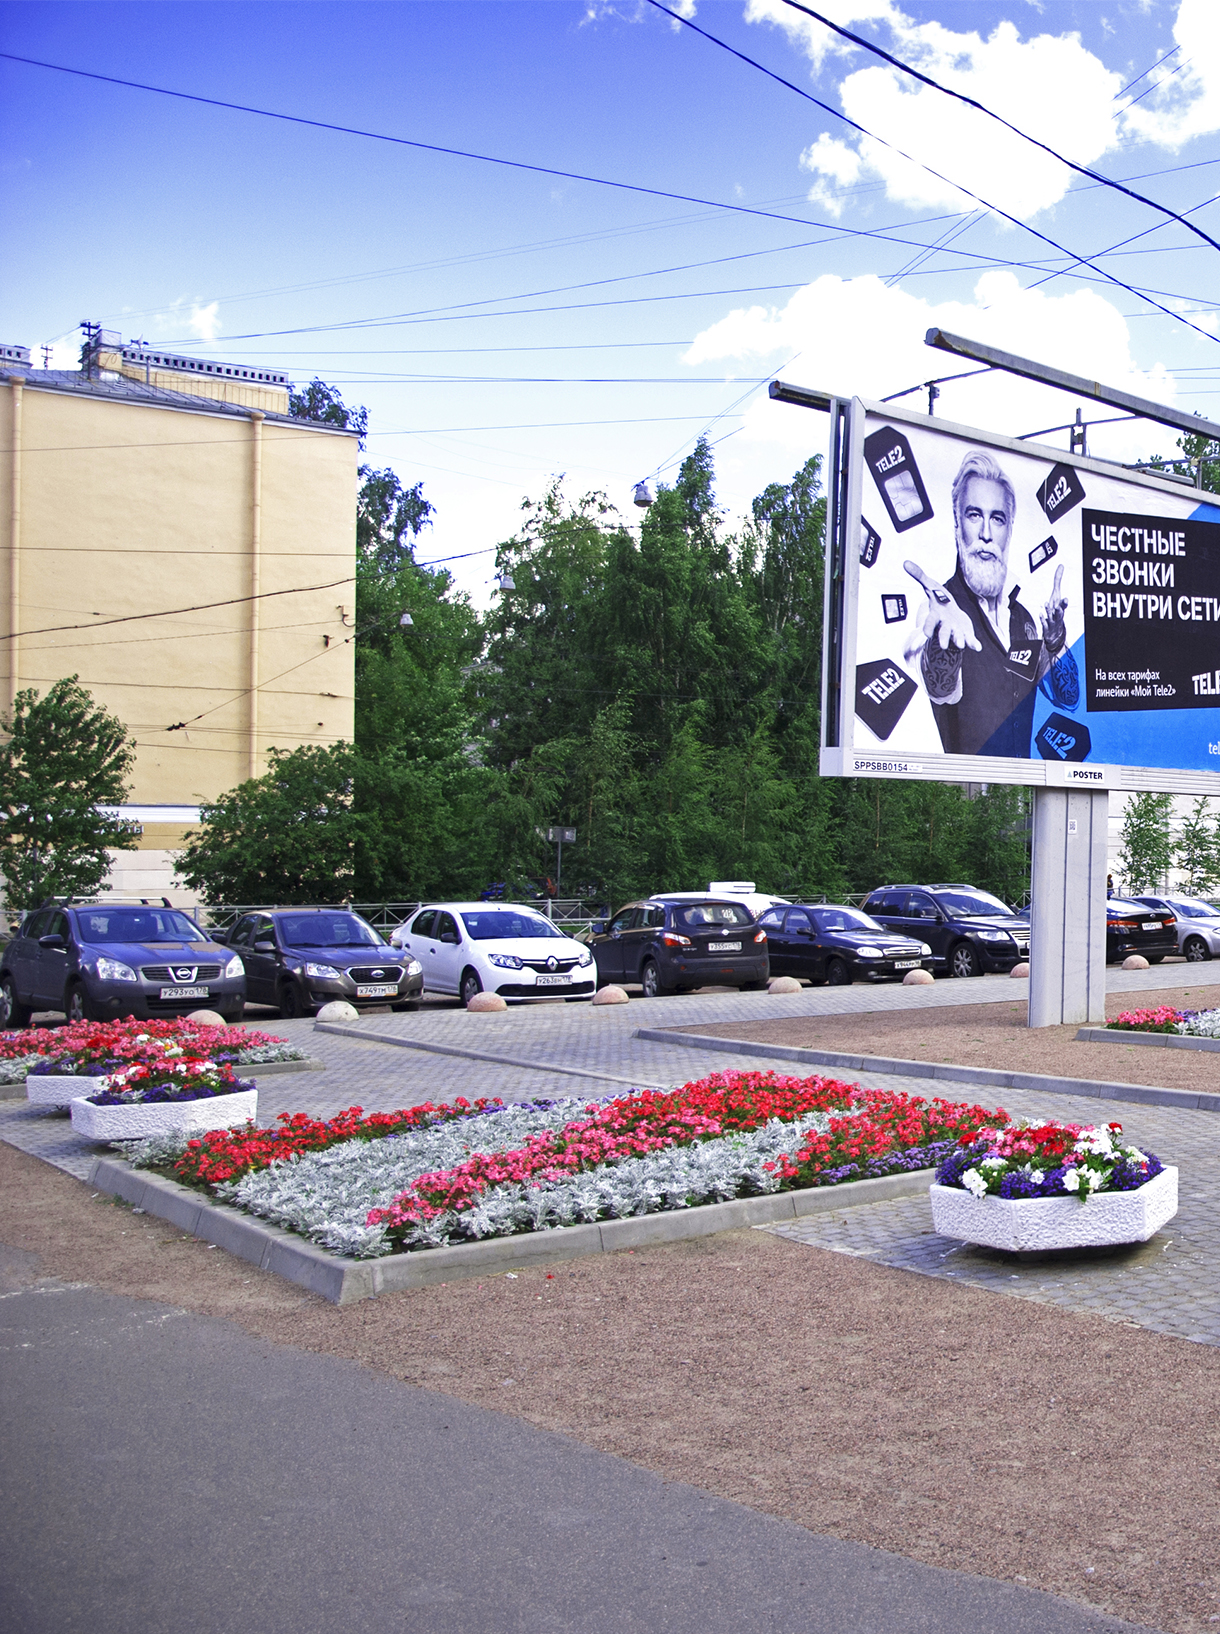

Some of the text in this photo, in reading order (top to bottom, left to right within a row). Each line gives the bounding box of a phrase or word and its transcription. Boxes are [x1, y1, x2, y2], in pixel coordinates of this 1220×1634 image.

[875, 445, 906, 474] TELE2
[1046, 476, 1072, 511] TELE2
[1091, 523, 1186, 557] ЧЕСТНЫЕ
[1091, 557, 1175, 588] ЗВОНКИ
[1092, 591, 1173, 620] ВНУТРИ
[1009, 649, 1032, 666] TELE2
[861, 667, 906, 705] TELE2
[1095, 669, 1160, 684] На всех тарифах
[1095, 684, 1177, 698] линейки «Мой Tele2»
[1043, 726, 1076, 759] TELE2
[854, 760, 908, 772] SPPSBB0154
[1073, 770, 1103, 780] POSTER
